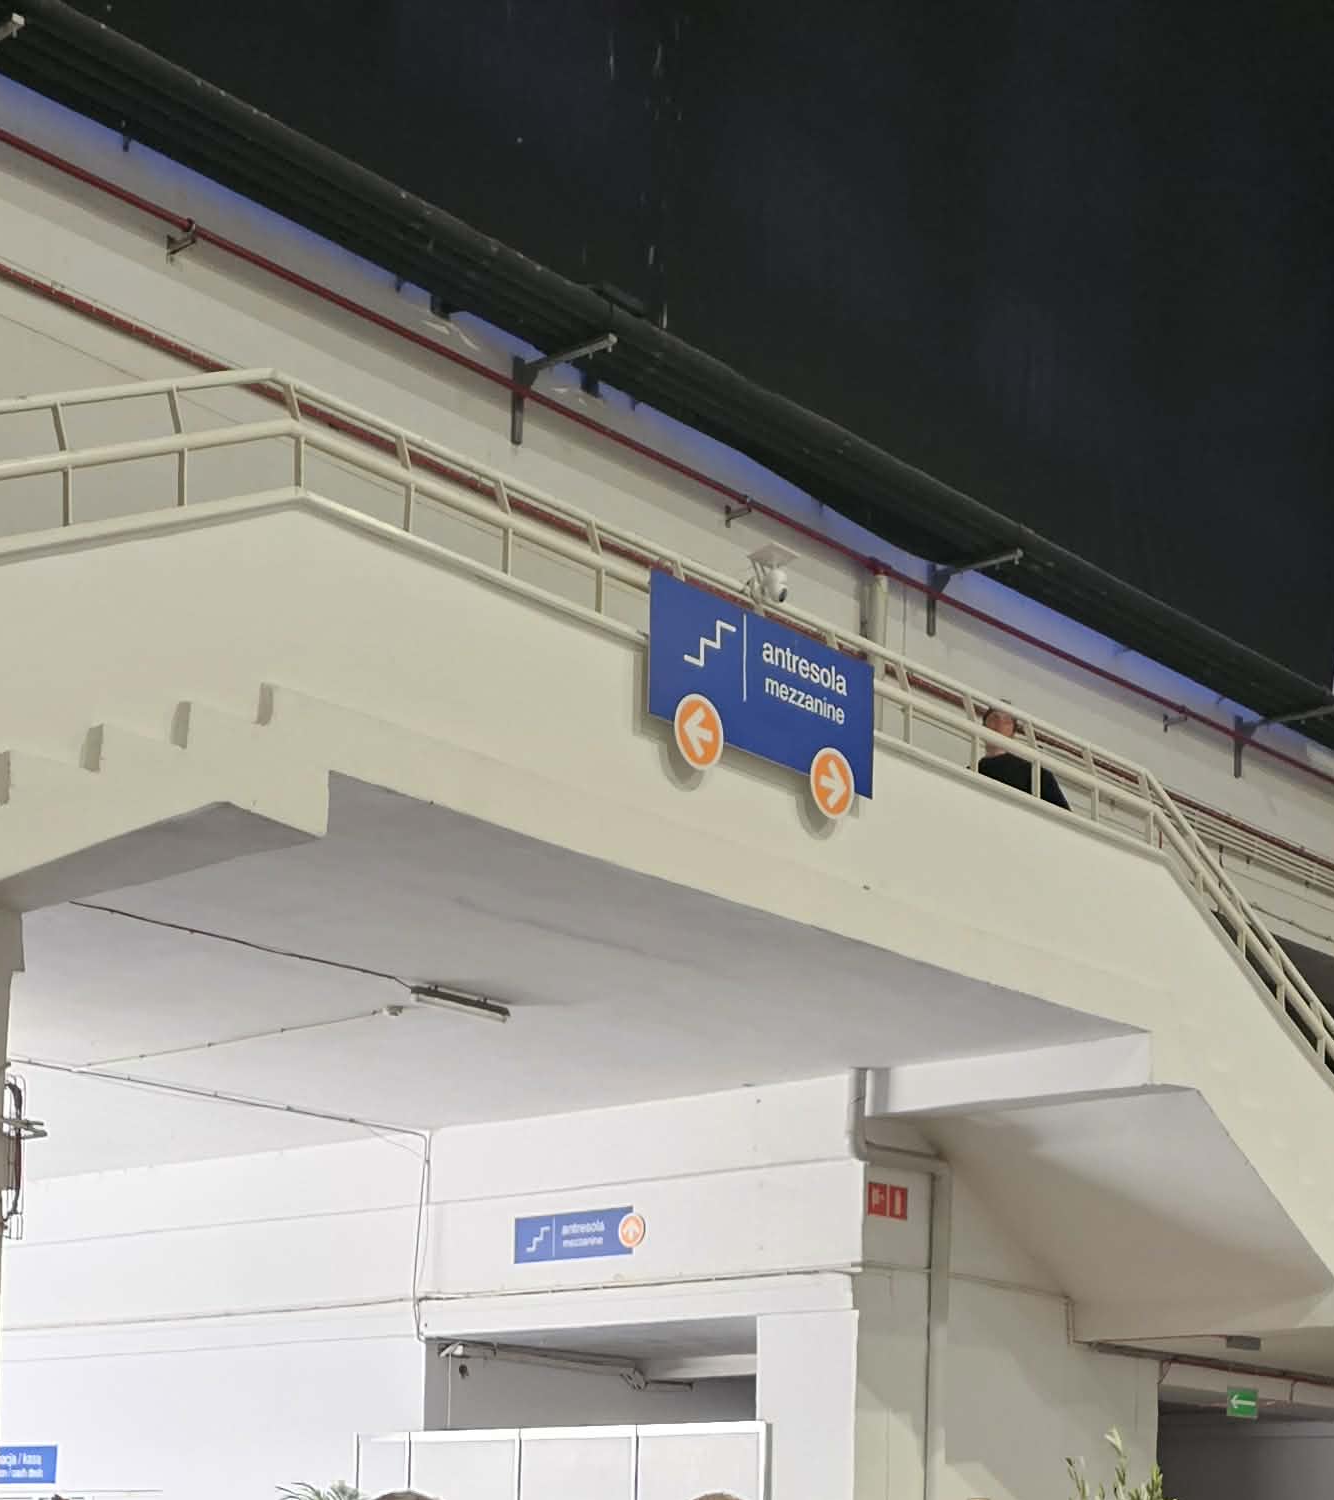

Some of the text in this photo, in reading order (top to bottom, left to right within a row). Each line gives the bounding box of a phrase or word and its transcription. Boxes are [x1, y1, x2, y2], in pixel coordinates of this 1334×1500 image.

[762, 641, 847, 696] antresola
[765, 676, 845, 725] mezzanine
[562, 1220, 605, 1236] antresola
